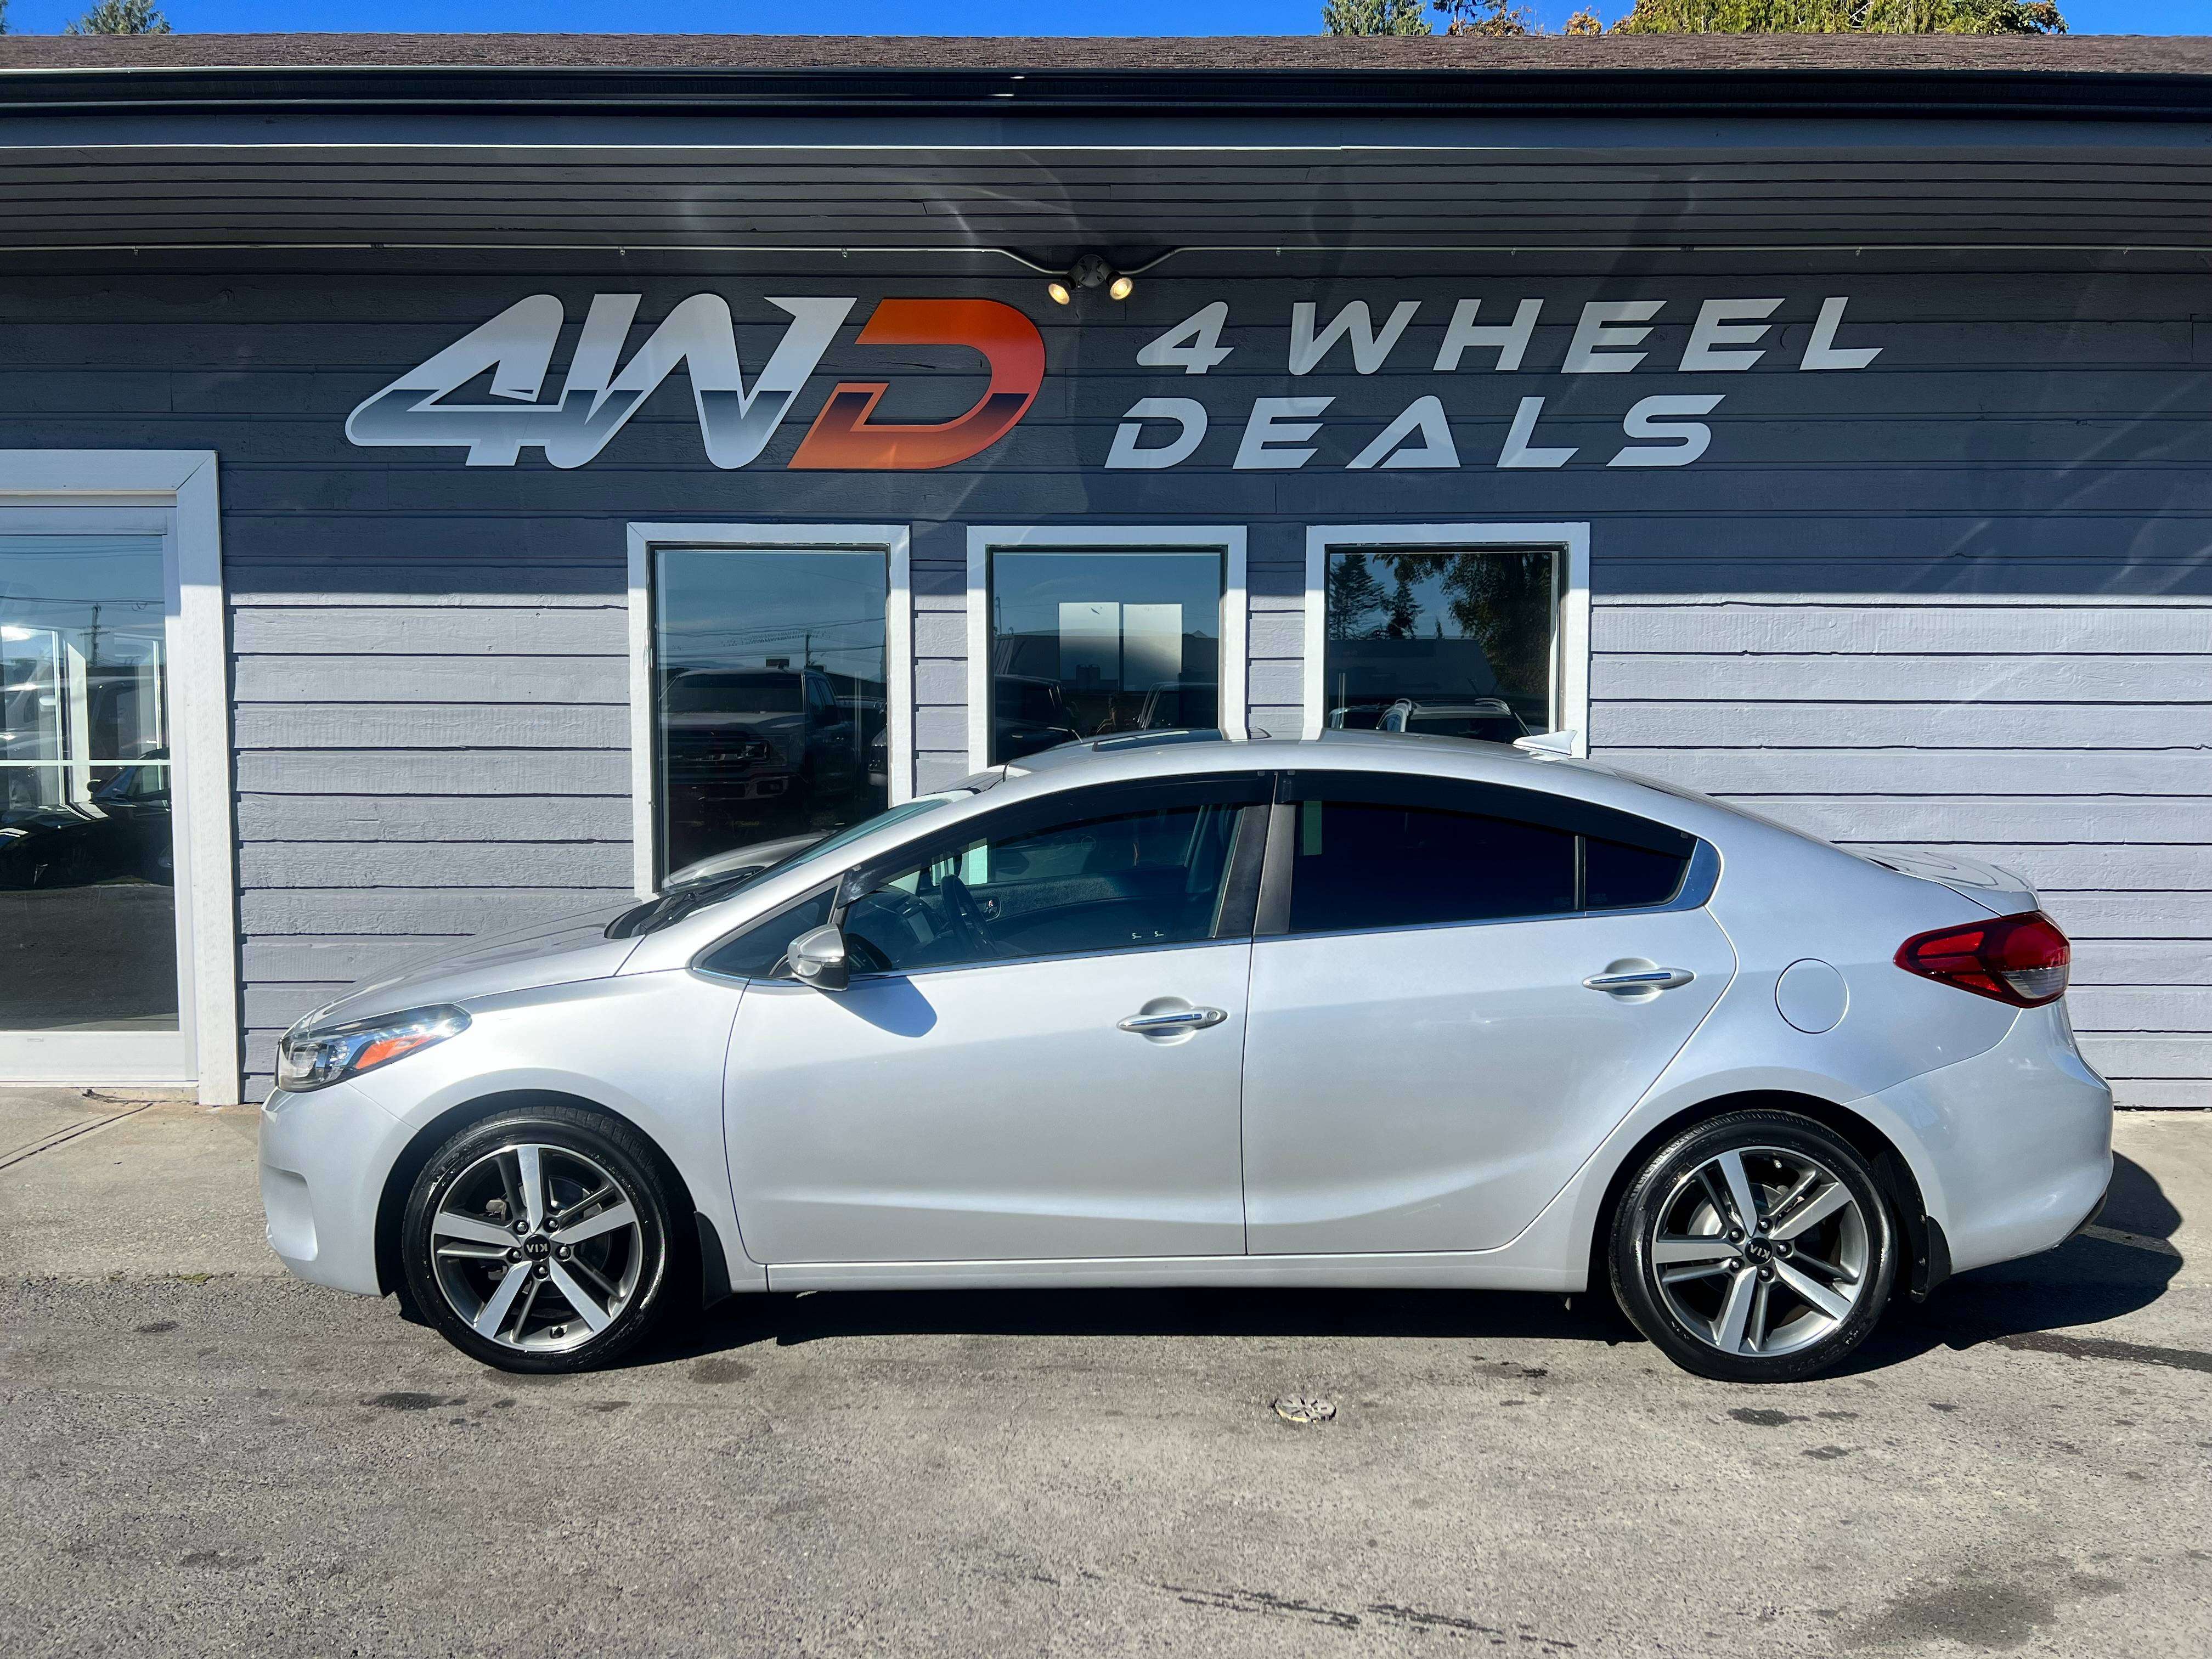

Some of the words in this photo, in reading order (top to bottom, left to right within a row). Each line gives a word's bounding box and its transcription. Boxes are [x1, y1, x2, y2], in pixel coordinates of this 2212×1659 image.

[1136, 301, 1234, 374] 4
[1288, 296, 1884, 375] WHEEL
[345, 293, 1046, 470] 4WD
[1104, 394, 1727, 470] DEALS
[526, 1243, 548, 1253] KIA
[1750, 1244, 1770, 1259] KIA
